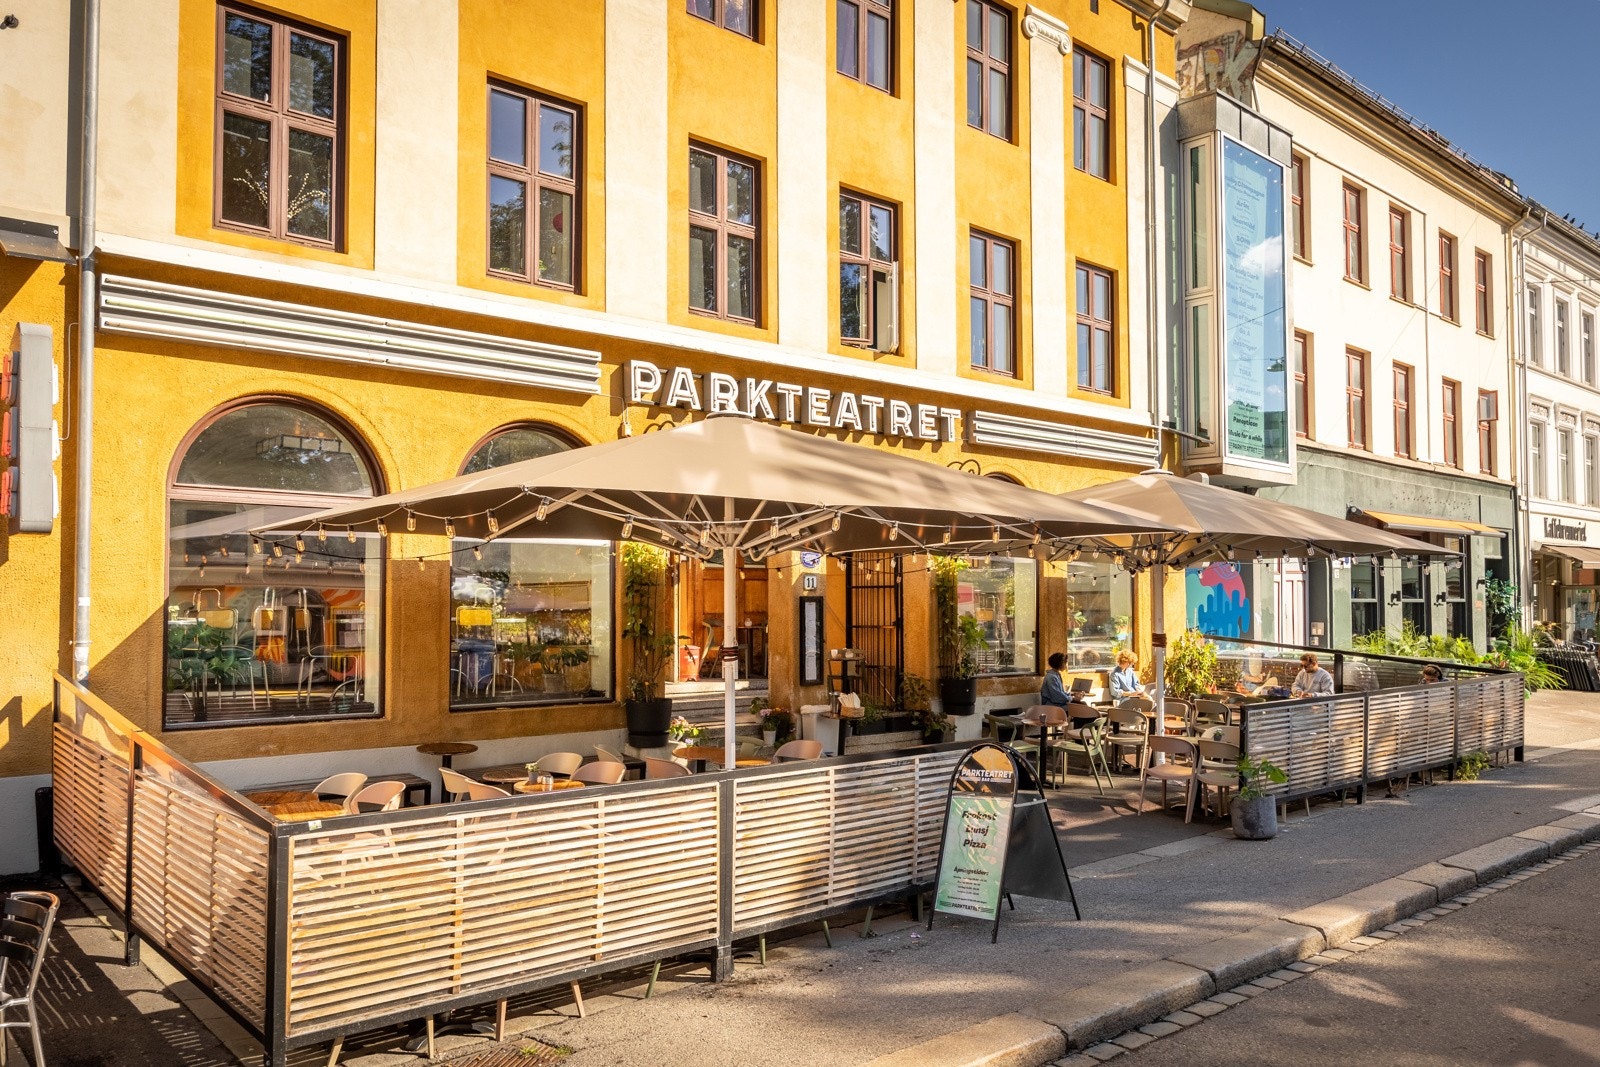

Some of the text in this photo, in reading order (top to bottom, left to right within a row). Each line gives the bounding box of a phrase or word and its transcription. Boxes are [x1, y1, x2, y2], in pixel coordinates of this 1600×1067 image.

[630, 359, 962, 442] PARKTEATRET
[806, 577, 815, 589] 11
[961, 768, 1013, 778] PARKTEATRET
[961, 810, 998, 821] Frokost
[962, 838, 987, 850] Pizza
